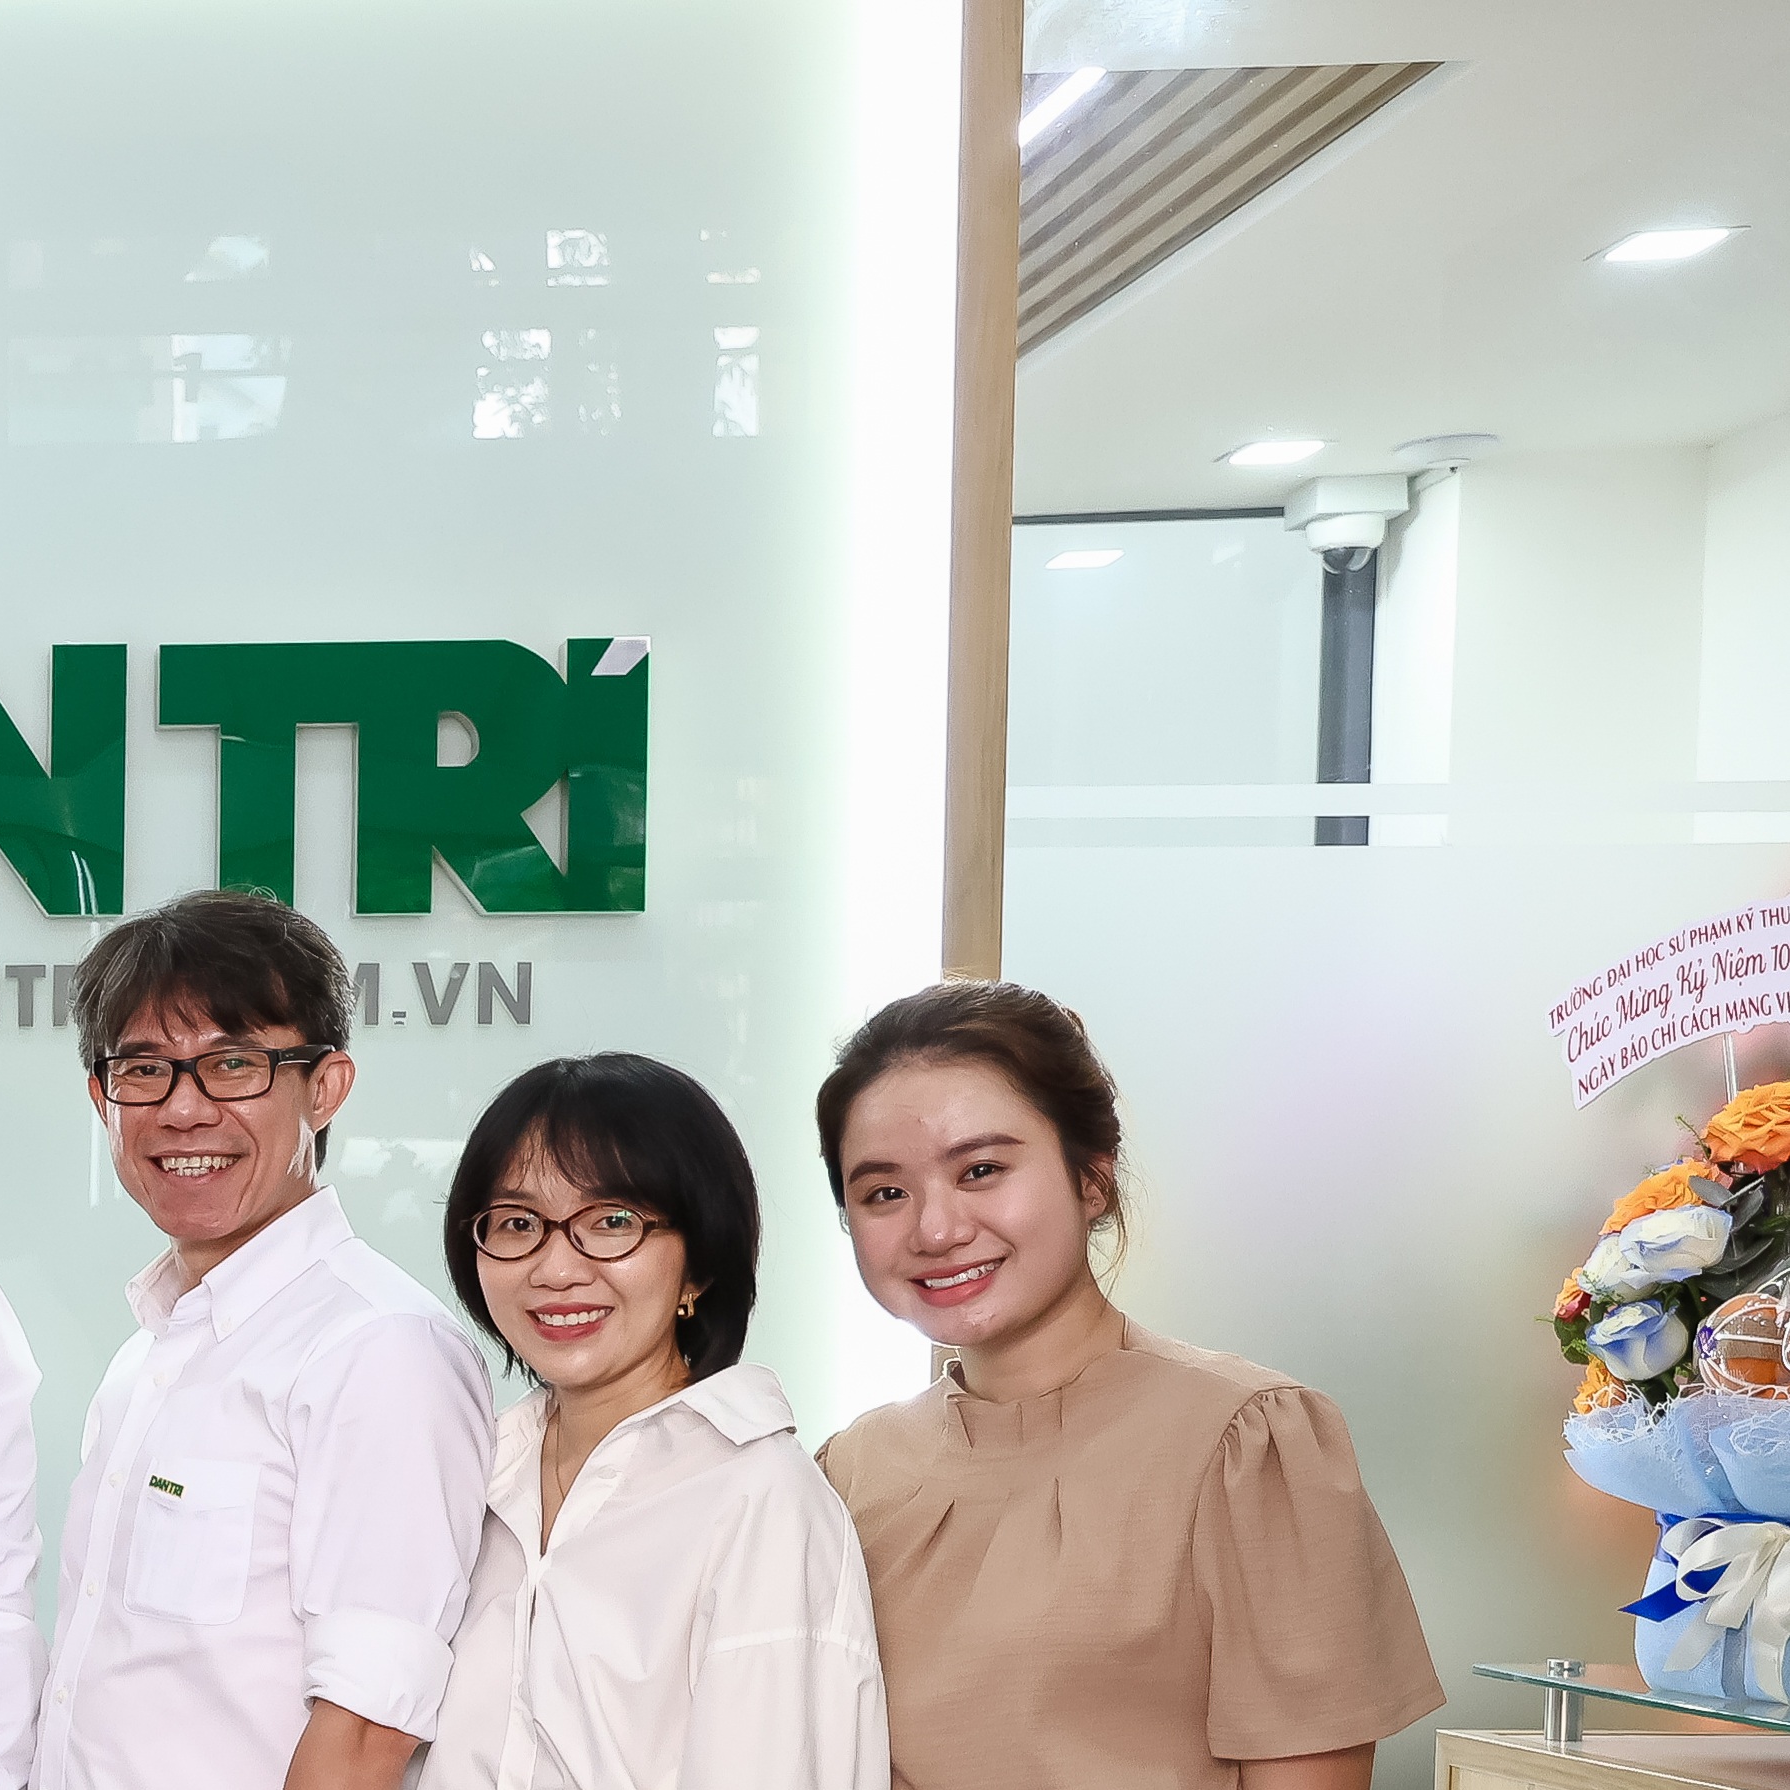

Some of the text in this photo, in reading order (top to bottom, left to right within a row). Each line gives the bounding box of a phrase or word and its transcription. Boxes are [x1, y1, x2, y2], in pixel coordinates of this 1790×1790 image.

[158, 635, 650, 916] TRÍ
[1548, 976, 1603, 1029] TRƯỜNG
[1607, 959, 1632, 988] ĐẠI
[1635, 942, 1665, 973] HỌC
[1668, 930, 1687, 957] SƯ
[1690, 917, 1732, 948] PHẠM
[1736, 907, 1755, 933] KỸ
[1567, 1011, 1613, 1063] Chúc
[1616, 981, 1673, 1029] Mừng
[1676, 958, 1708, 1003] Kỷ
[1712, 947, 1767, 986] Niệm
[1577, 1051, 1617, 1101] NGÀY
[1620, 1033, 1648, 1069] BÁO
[1651, 1014, 1677, 1051] CHÍ
[1680, 1005, 1721, 1036] CÁCH
[1725, 993, 1772, 1026] MẠNG
